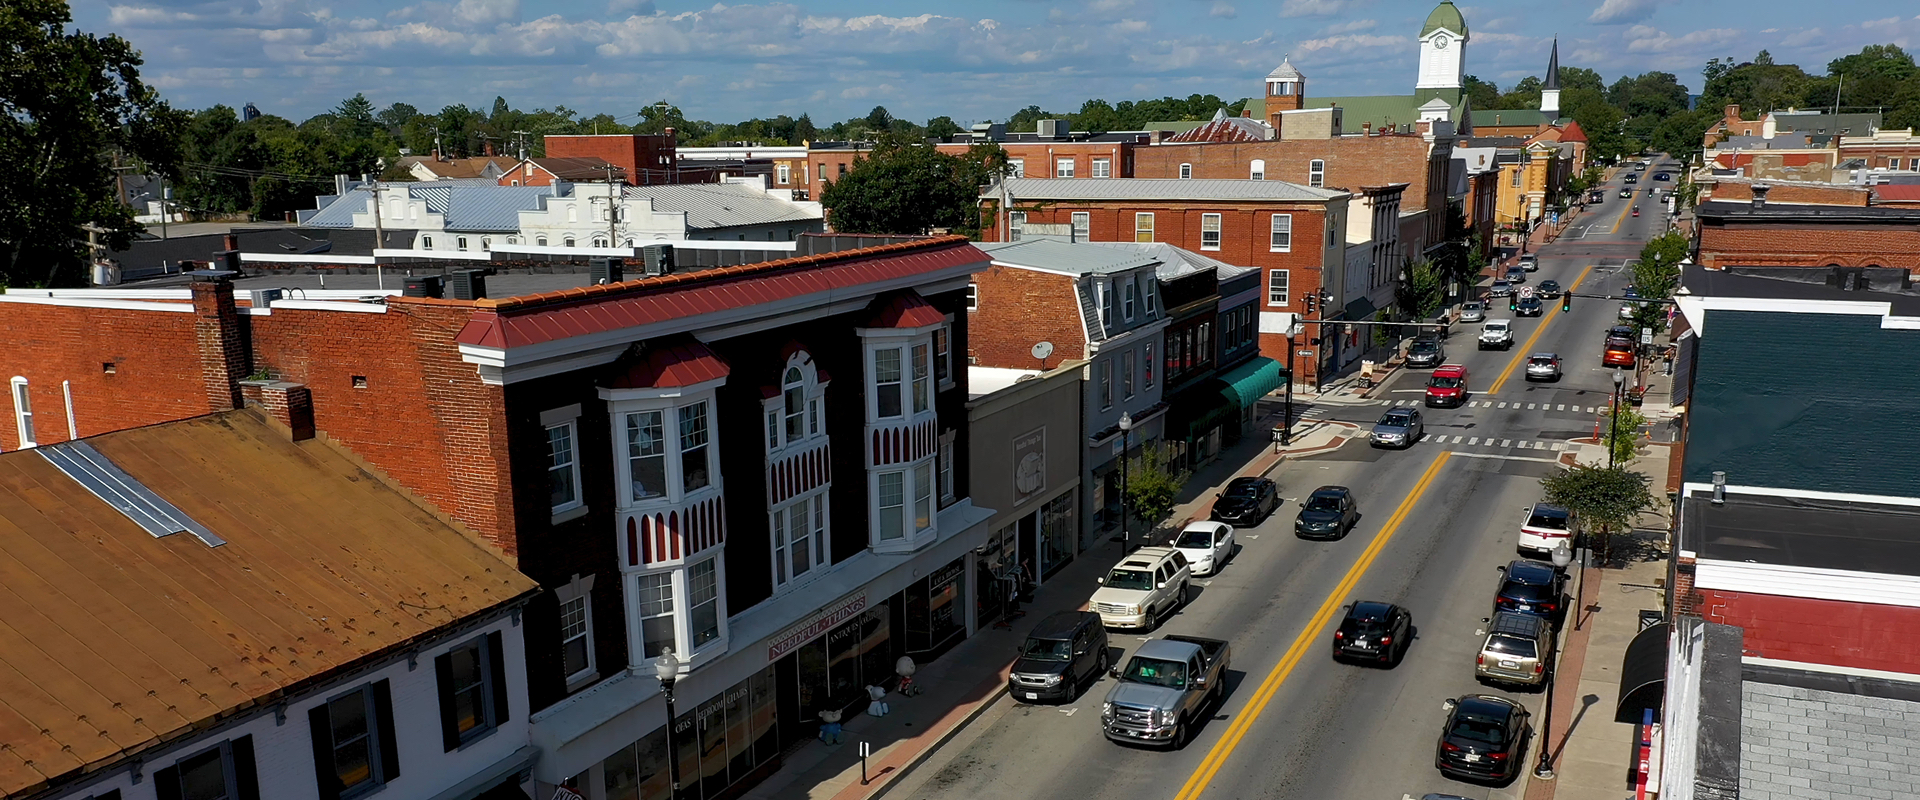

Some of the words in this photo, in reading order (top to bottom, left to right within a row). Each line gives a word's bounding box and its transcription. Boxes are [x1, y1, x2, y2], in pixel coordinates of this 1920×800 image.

[771, 622, 823, 657] NEEDFUL
[825, 598, 864, 627] THINGS
[830, 620, 859, 644] ANTIQUES
[675, 717, 692, 734] OFAS
[698, 699, 724, 721] BEDROOM
[727, 686, 748, 705] CHAIRS
